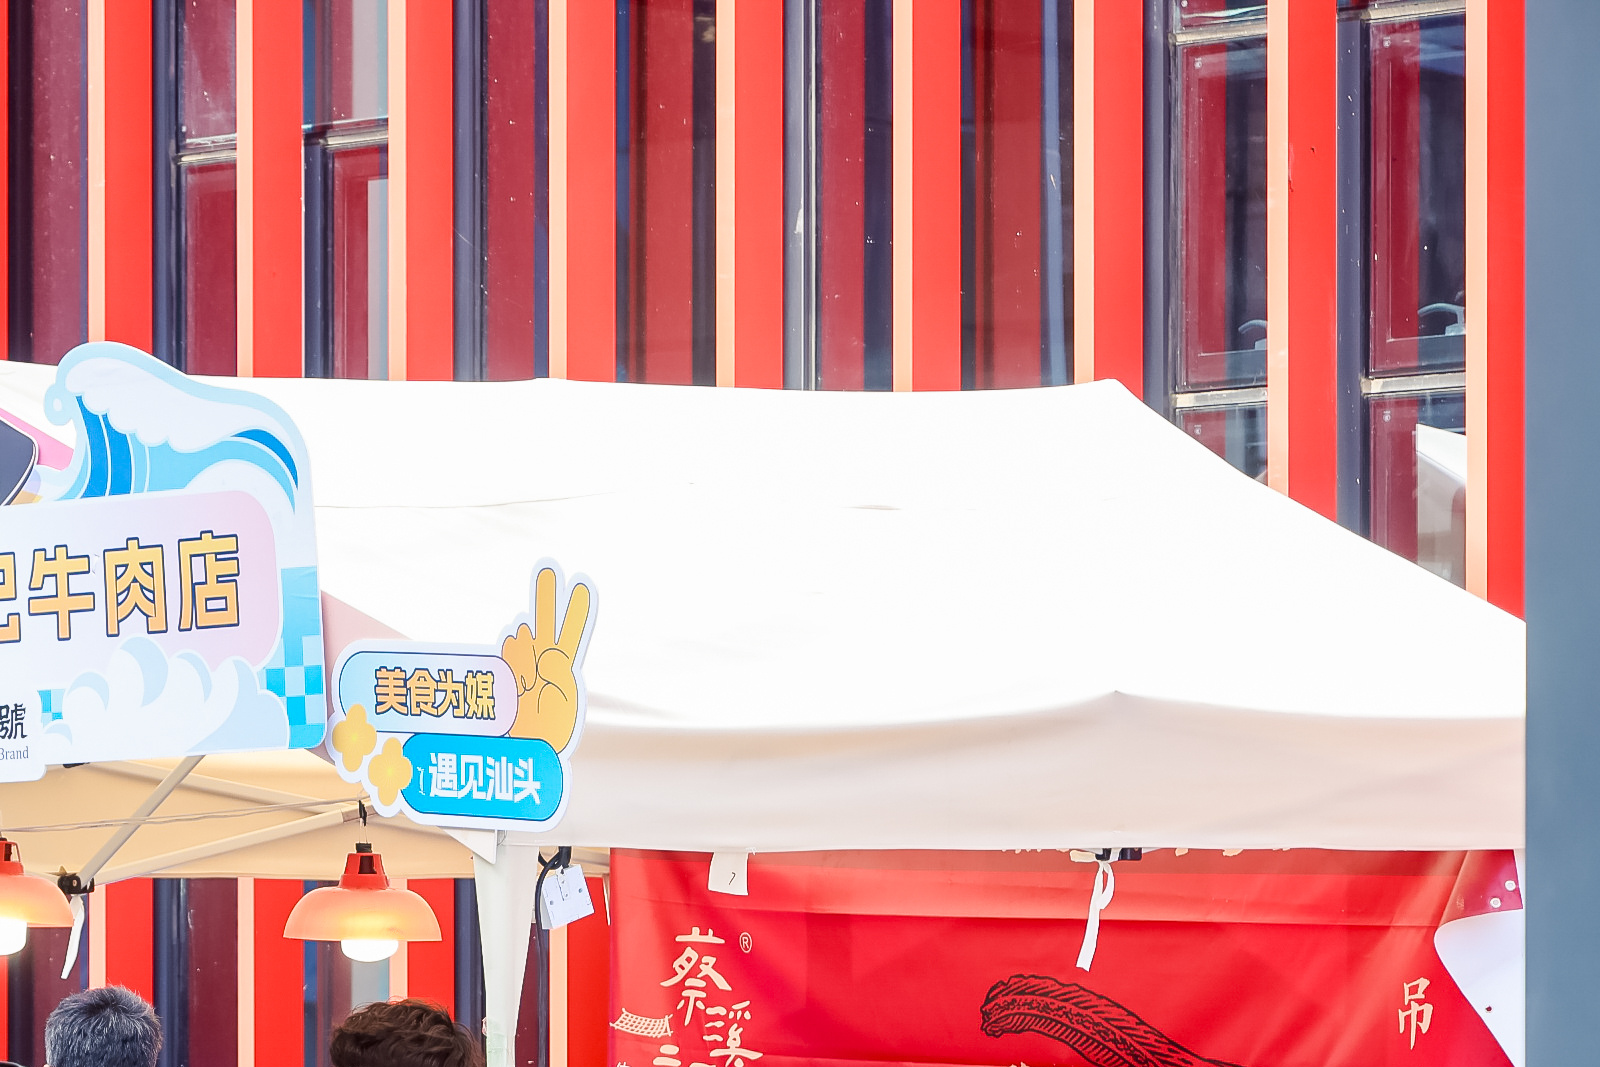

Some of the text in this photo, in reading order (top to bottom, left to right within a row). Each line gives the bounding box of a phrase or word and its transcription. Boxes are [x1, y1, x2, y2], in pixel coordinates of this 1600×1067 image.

[374, 665, 496, 720] 美食为媒
[428, 752, 542, 805] 遇见汕头
